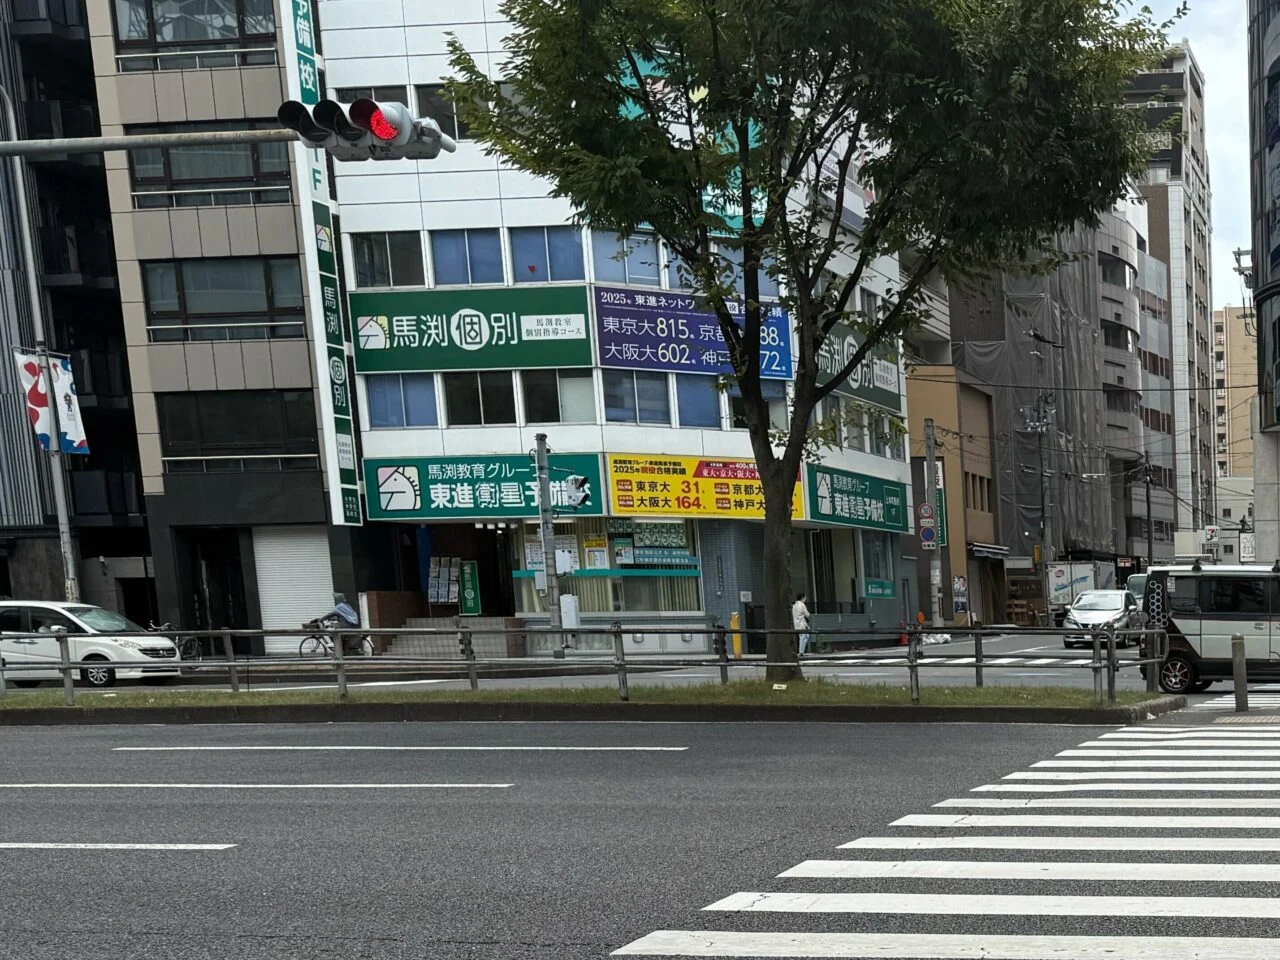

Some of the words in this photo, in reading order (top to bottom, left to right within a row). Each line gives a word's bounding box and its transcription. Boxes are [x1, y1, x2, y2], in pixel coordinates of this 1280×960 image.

[635, 480, 671, 493] 東京大
[637, 495, 672, 508] 大阪大
